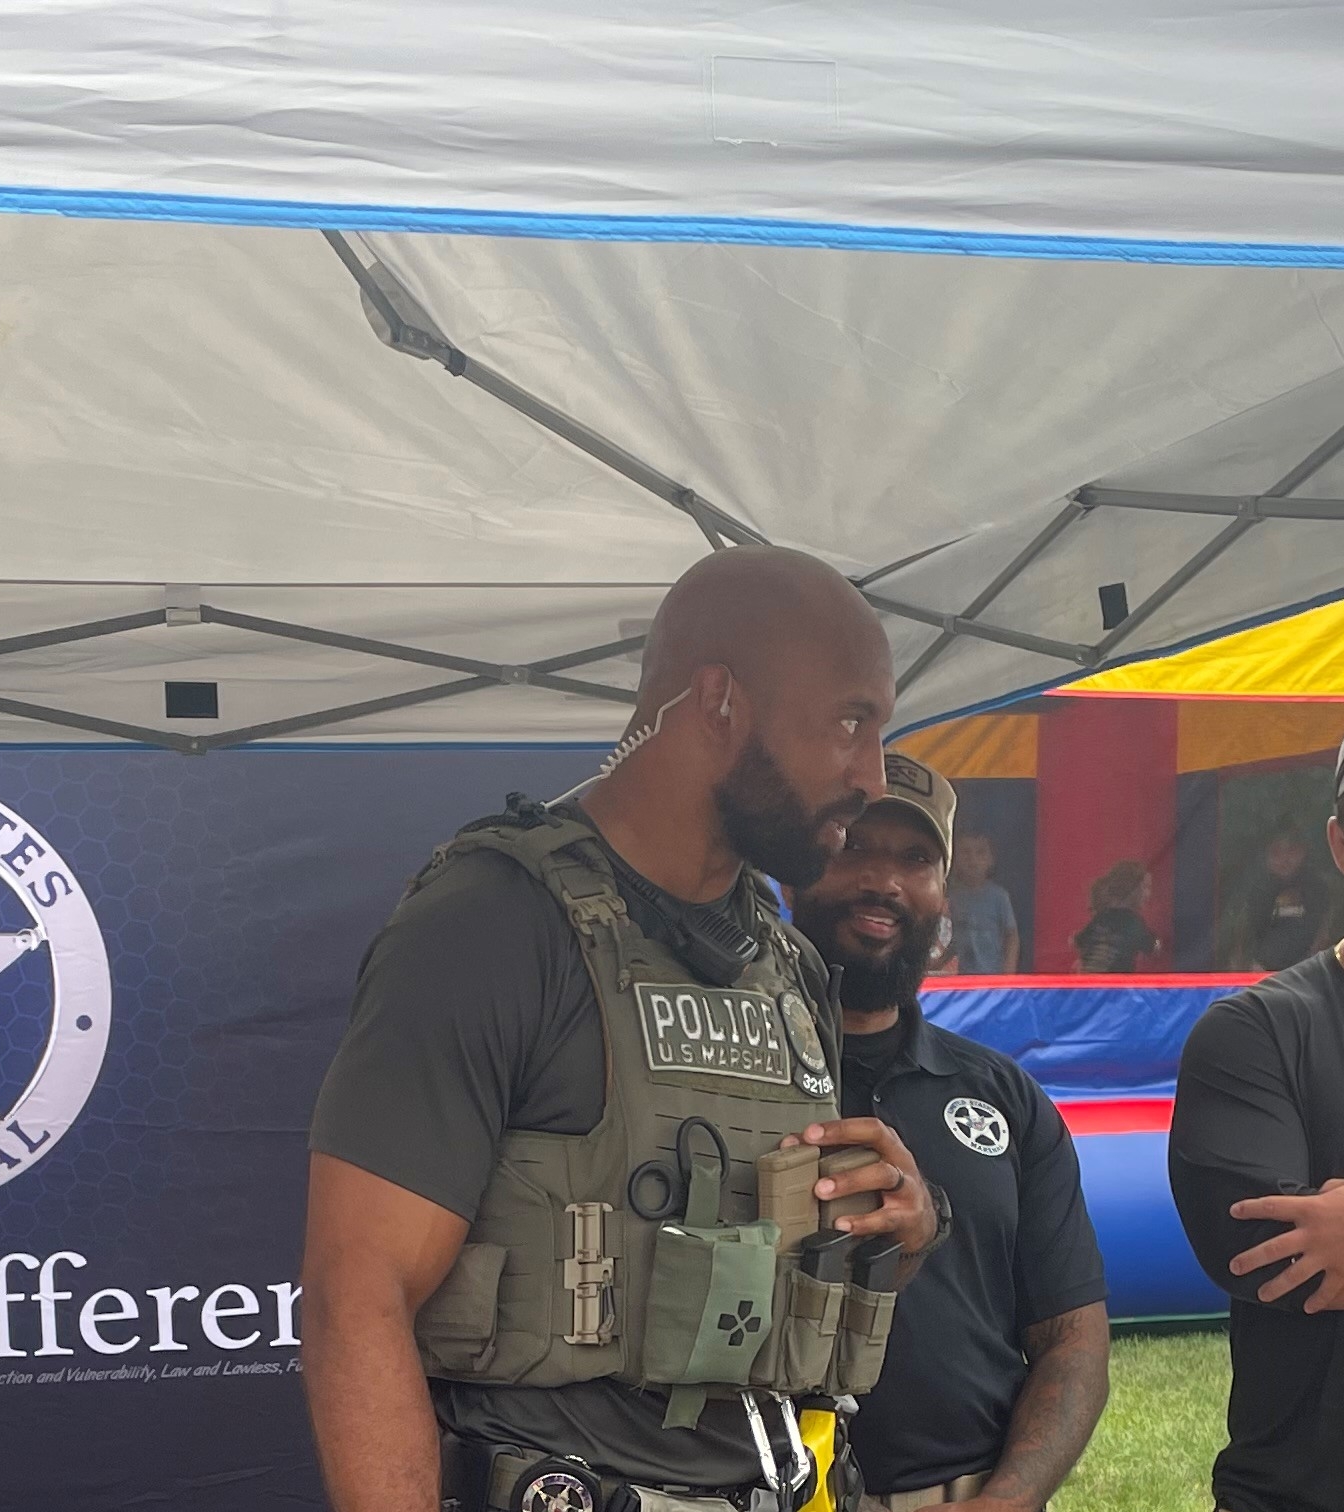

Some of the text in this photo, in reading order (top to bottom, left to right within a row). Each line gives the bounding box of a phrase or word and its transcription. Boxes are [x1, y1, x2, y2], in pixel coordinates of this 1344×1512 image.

[650, 994, 779, 1050] POLICE
[36, 1367, 65, 1384] and
[66, 1364, 157, 1384] Vulnerability,
[161, 1363, 192, 1379] Law
[194, 1360, 222, 1376] and
[222, 1358, 283, 1378] Lawless,
